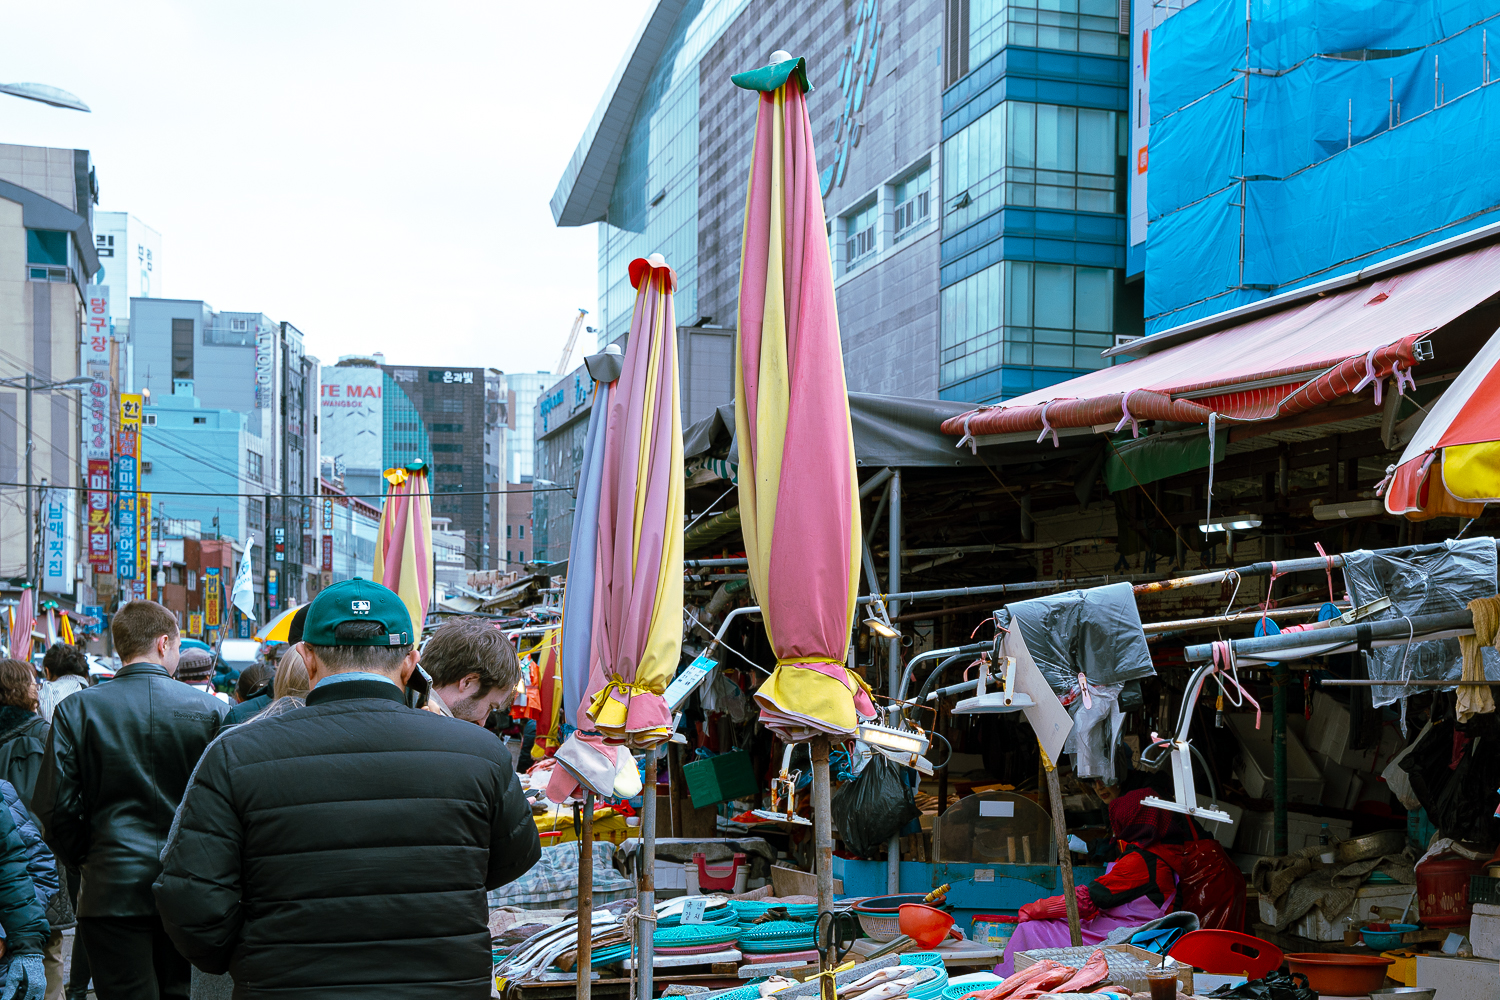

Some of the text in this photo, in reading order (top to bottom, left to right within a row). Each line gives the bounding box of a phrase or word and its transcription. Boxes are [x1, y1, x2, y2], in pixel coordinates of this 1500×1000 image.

[90, 298, 107, 352] 당구장
[257, 325, 271, 385] ALMOND
[49, 502, 64, 577] 남매횟집
